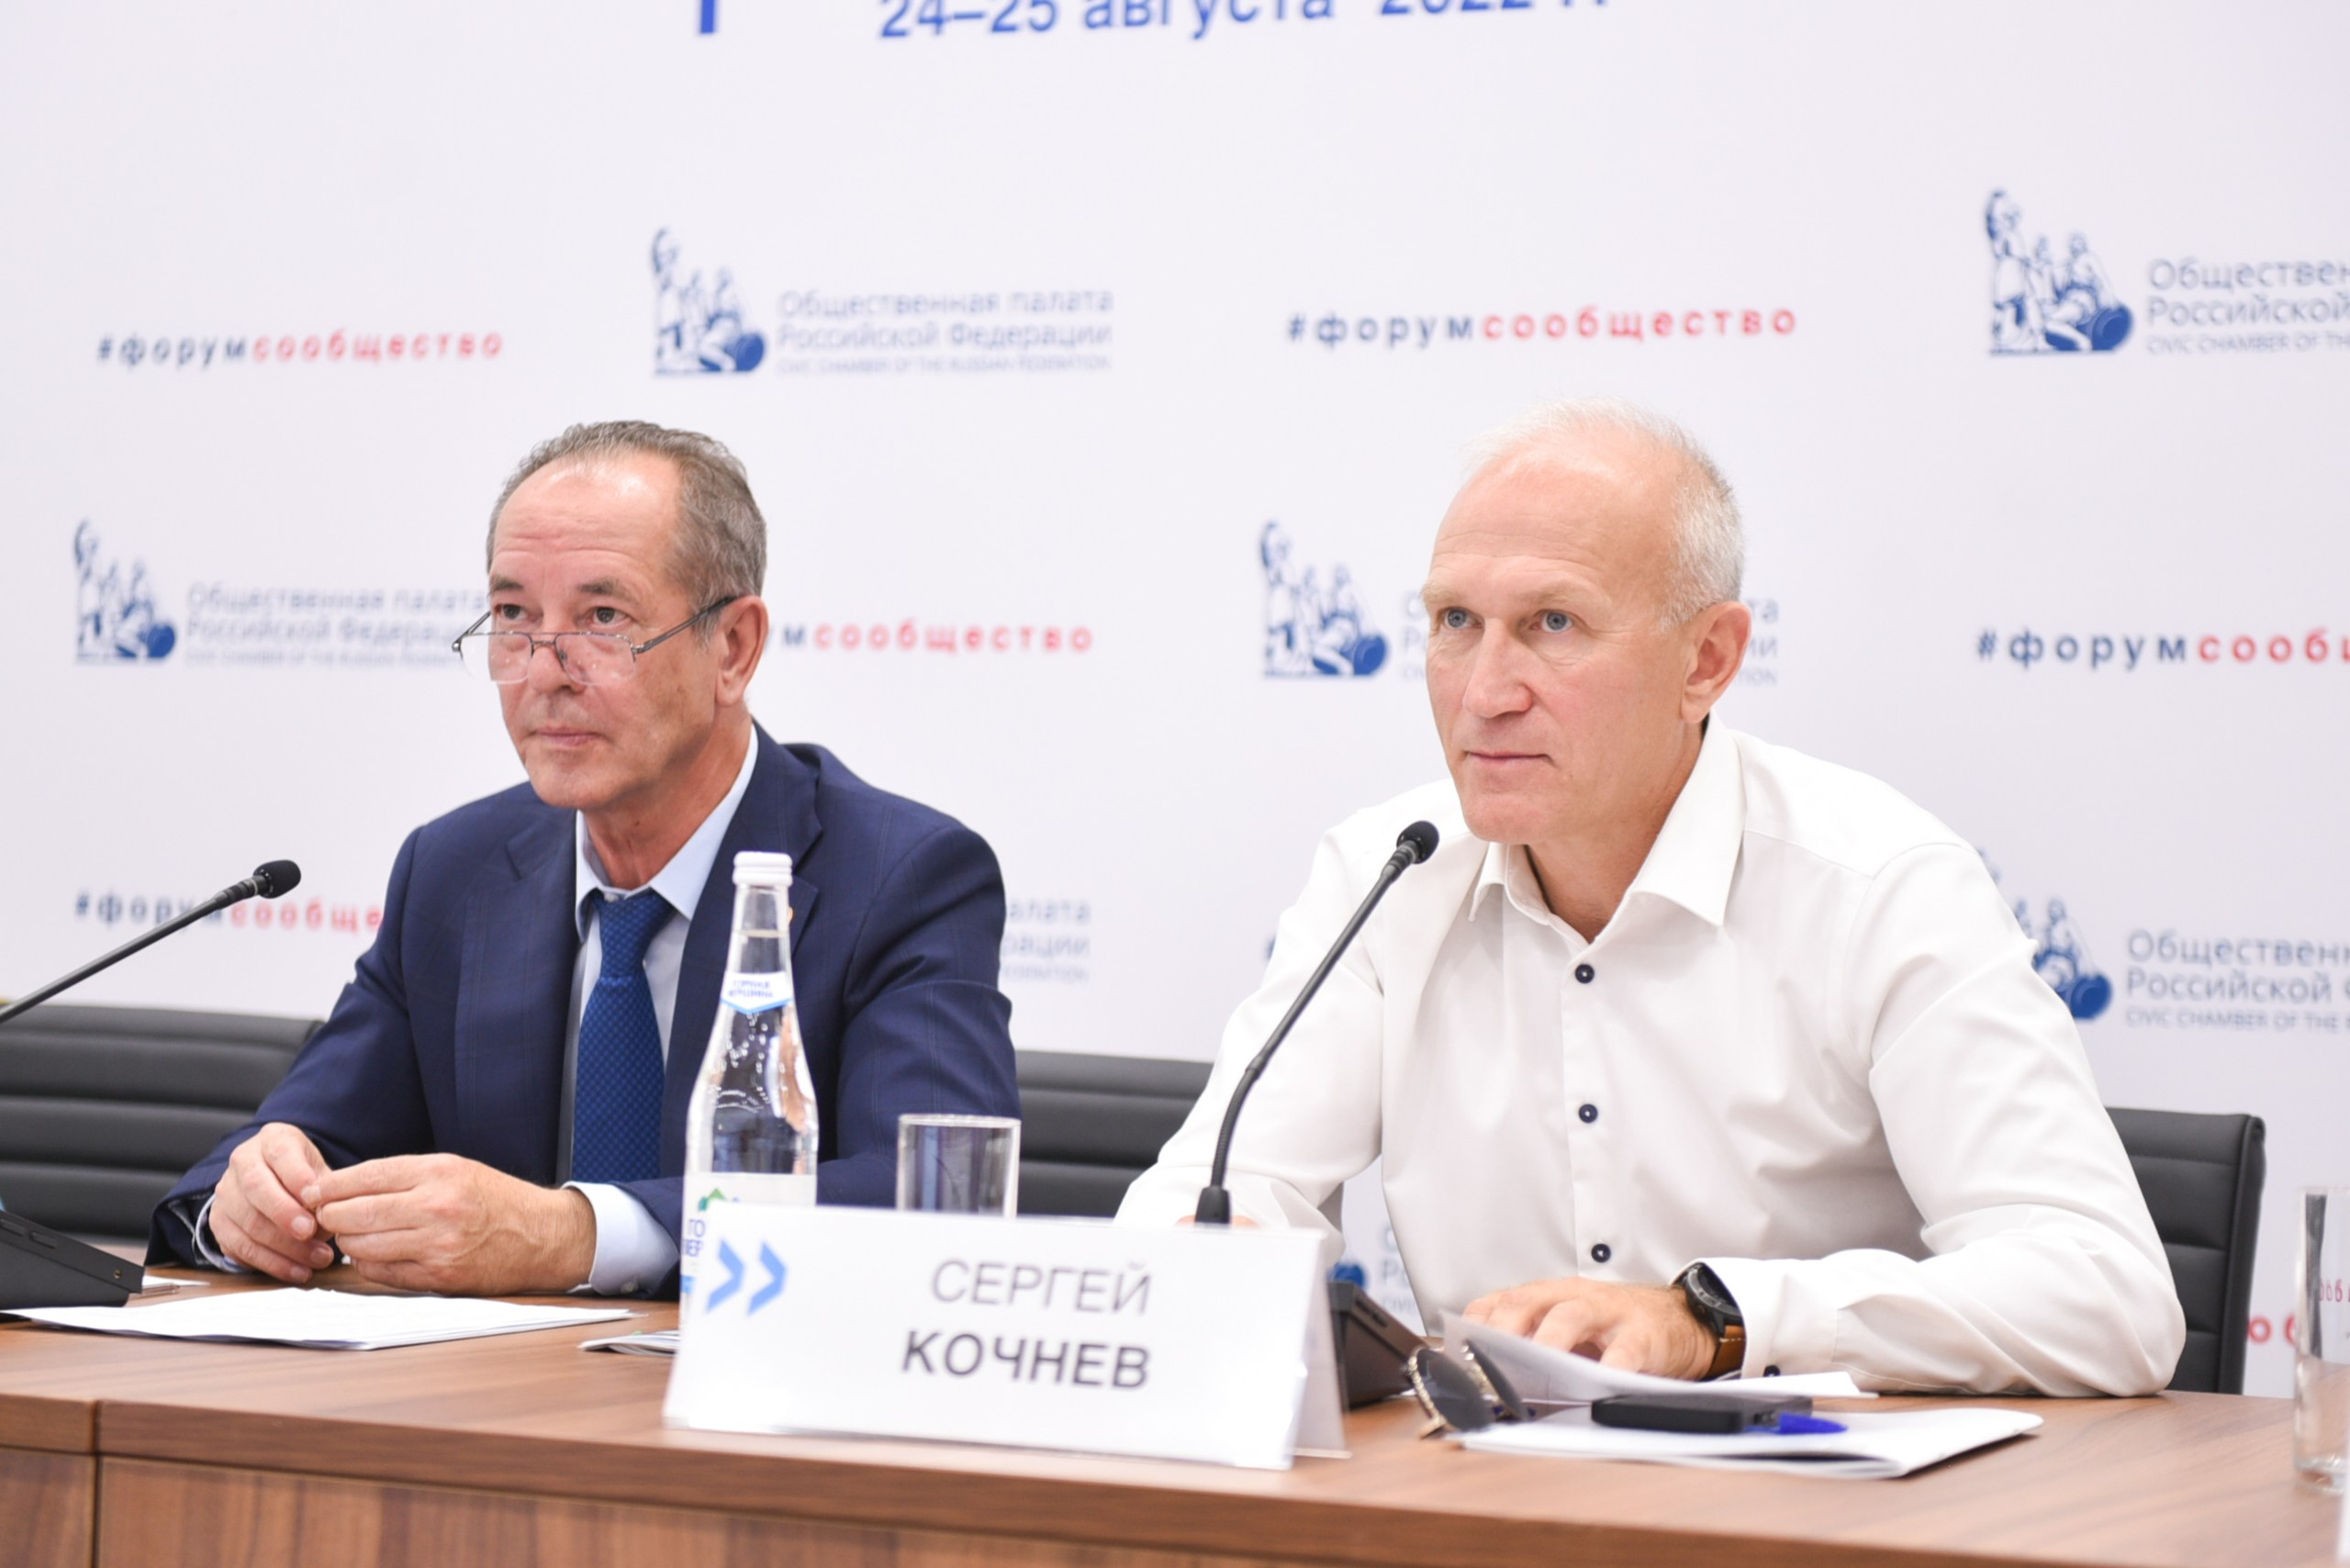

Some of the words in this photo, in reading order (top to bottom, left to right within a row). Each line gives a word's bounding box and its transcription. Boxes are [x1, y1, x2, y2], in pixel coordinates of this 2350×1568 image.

[1287, 306, 1796, 348] #форумсообщество
[97, 328, 504, 371] #форумсообщество
[2127, 965, 2333, 1004] Российской
[930, 1259, 1151, 1316] СЕРГЕЙ
[901, 1329, 1150, 1389] КОЧНЕВ
